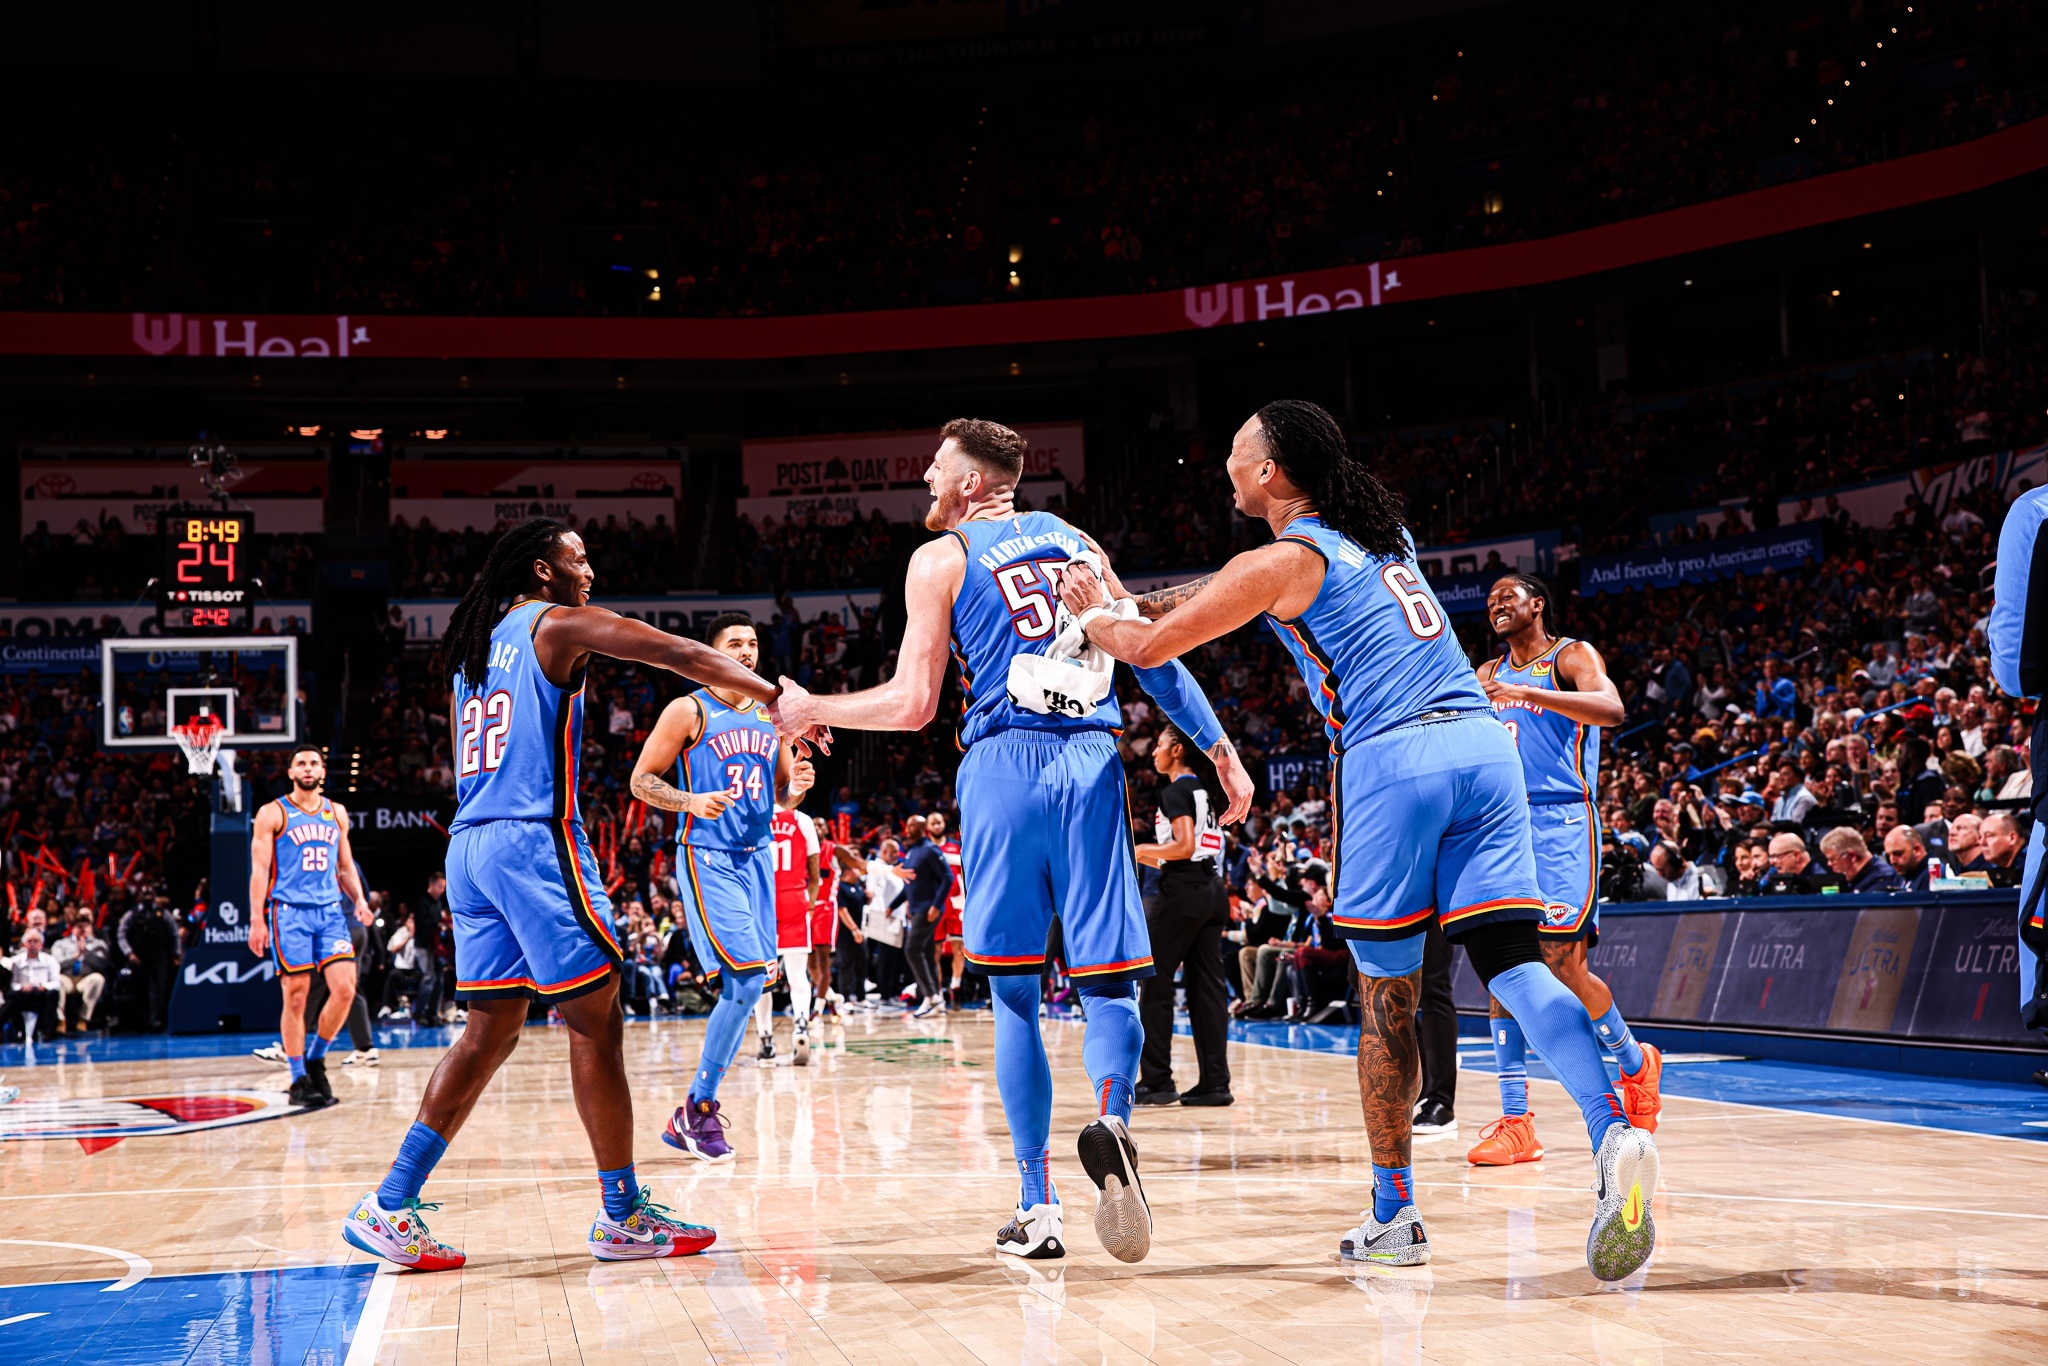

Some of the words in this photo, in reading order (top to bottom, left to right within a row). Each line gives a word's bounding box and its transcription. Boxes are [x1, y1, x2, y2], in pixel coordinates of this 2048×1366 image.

[777, 462, 821, 486] POST
[852, 458, 888, 482] OAK
[495, 502, 526, 519] POST
[547, 502, 571, 518] OAK
[187, 519, 240, 543] 8:49
[177, 542, 236, 583] 24
[1590, 566, 1621, 584] And
[1624, 556, 1676, 580] fiercely
[1678, 558, 1705, 577] pro
[1707, 543, 1767, 569] American
[187, 590, 245, 602] TISSOT
[1379, 561, 1445, 641] 6
[192, 608, 230, 627] 2:42
[2, 643, 100, 660] Continental
[460, 689, 513, 778] 22
[707, 729, 780, 761] THUNDER
[726, 764, 763, 800] 34
[375, 807, 439, 830] BANK
[286, 823, 338, 847] THUNDER
[301, 846, 329, 872] 25
[1593, 944, 1639, 968] ULTRA
[1747, 943, 1806, 970] ULTRA
